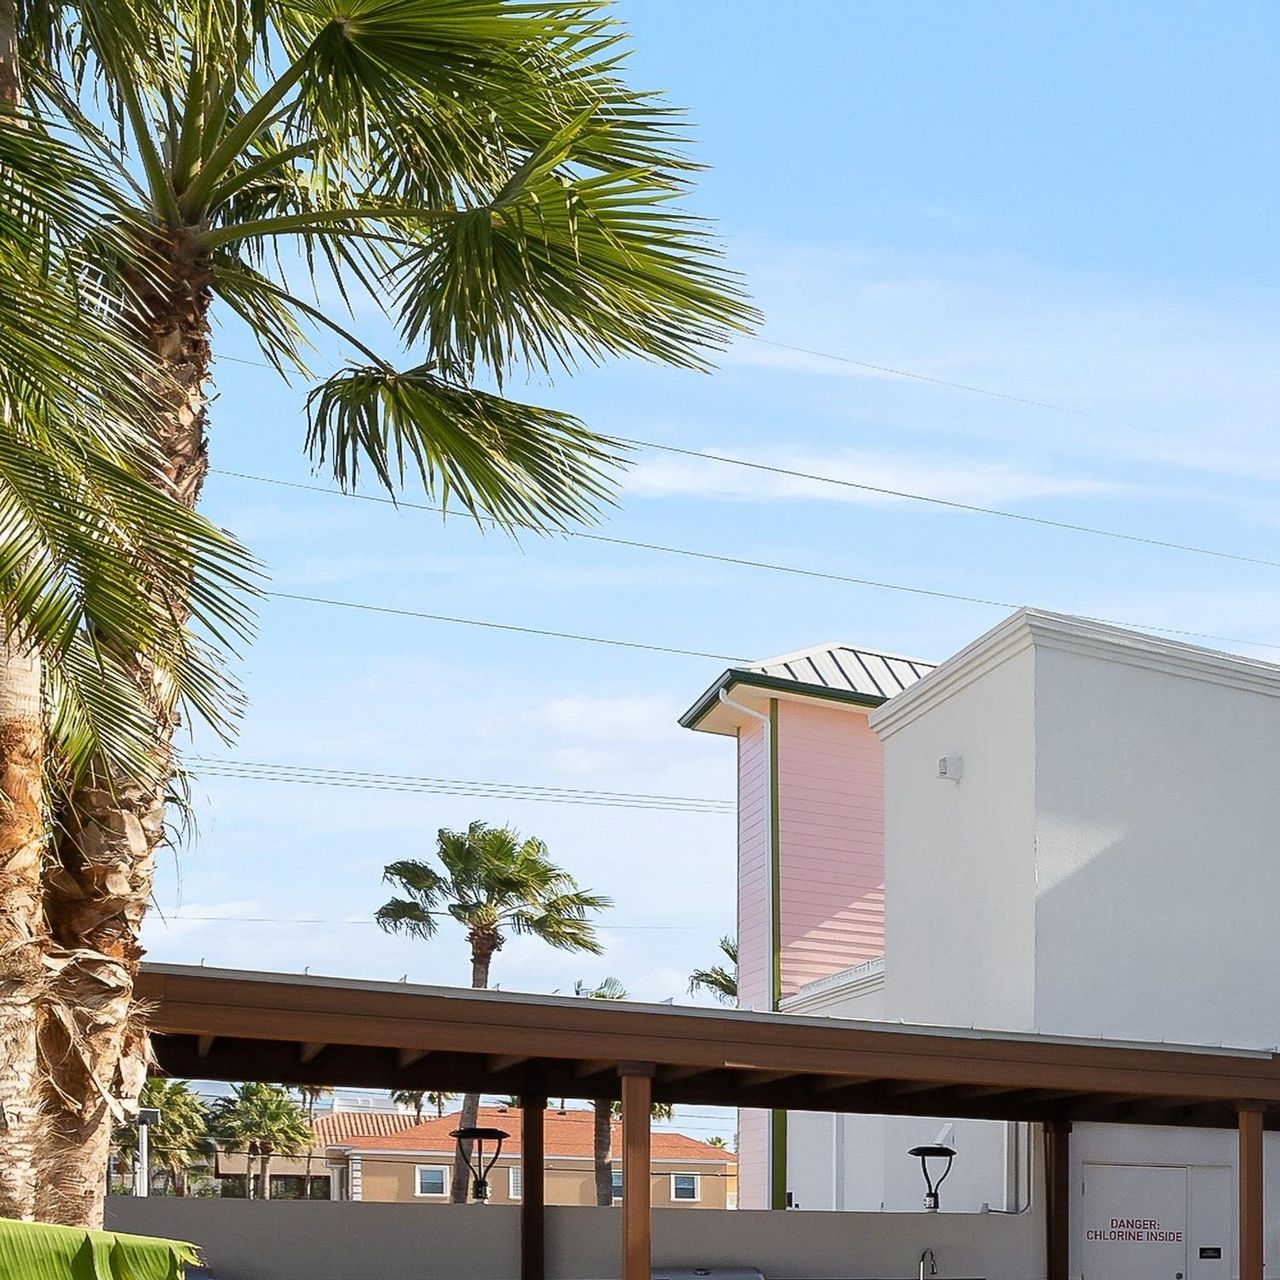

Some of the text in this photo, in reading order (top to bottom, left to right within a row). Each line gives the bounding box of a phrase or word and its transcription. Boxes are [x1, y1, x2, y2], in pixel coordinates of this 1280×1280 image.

[1110, 1219, 1160, 1230] DANGER:
[1086, 1230, 1183, 1242] CHLORINE INSIDE
